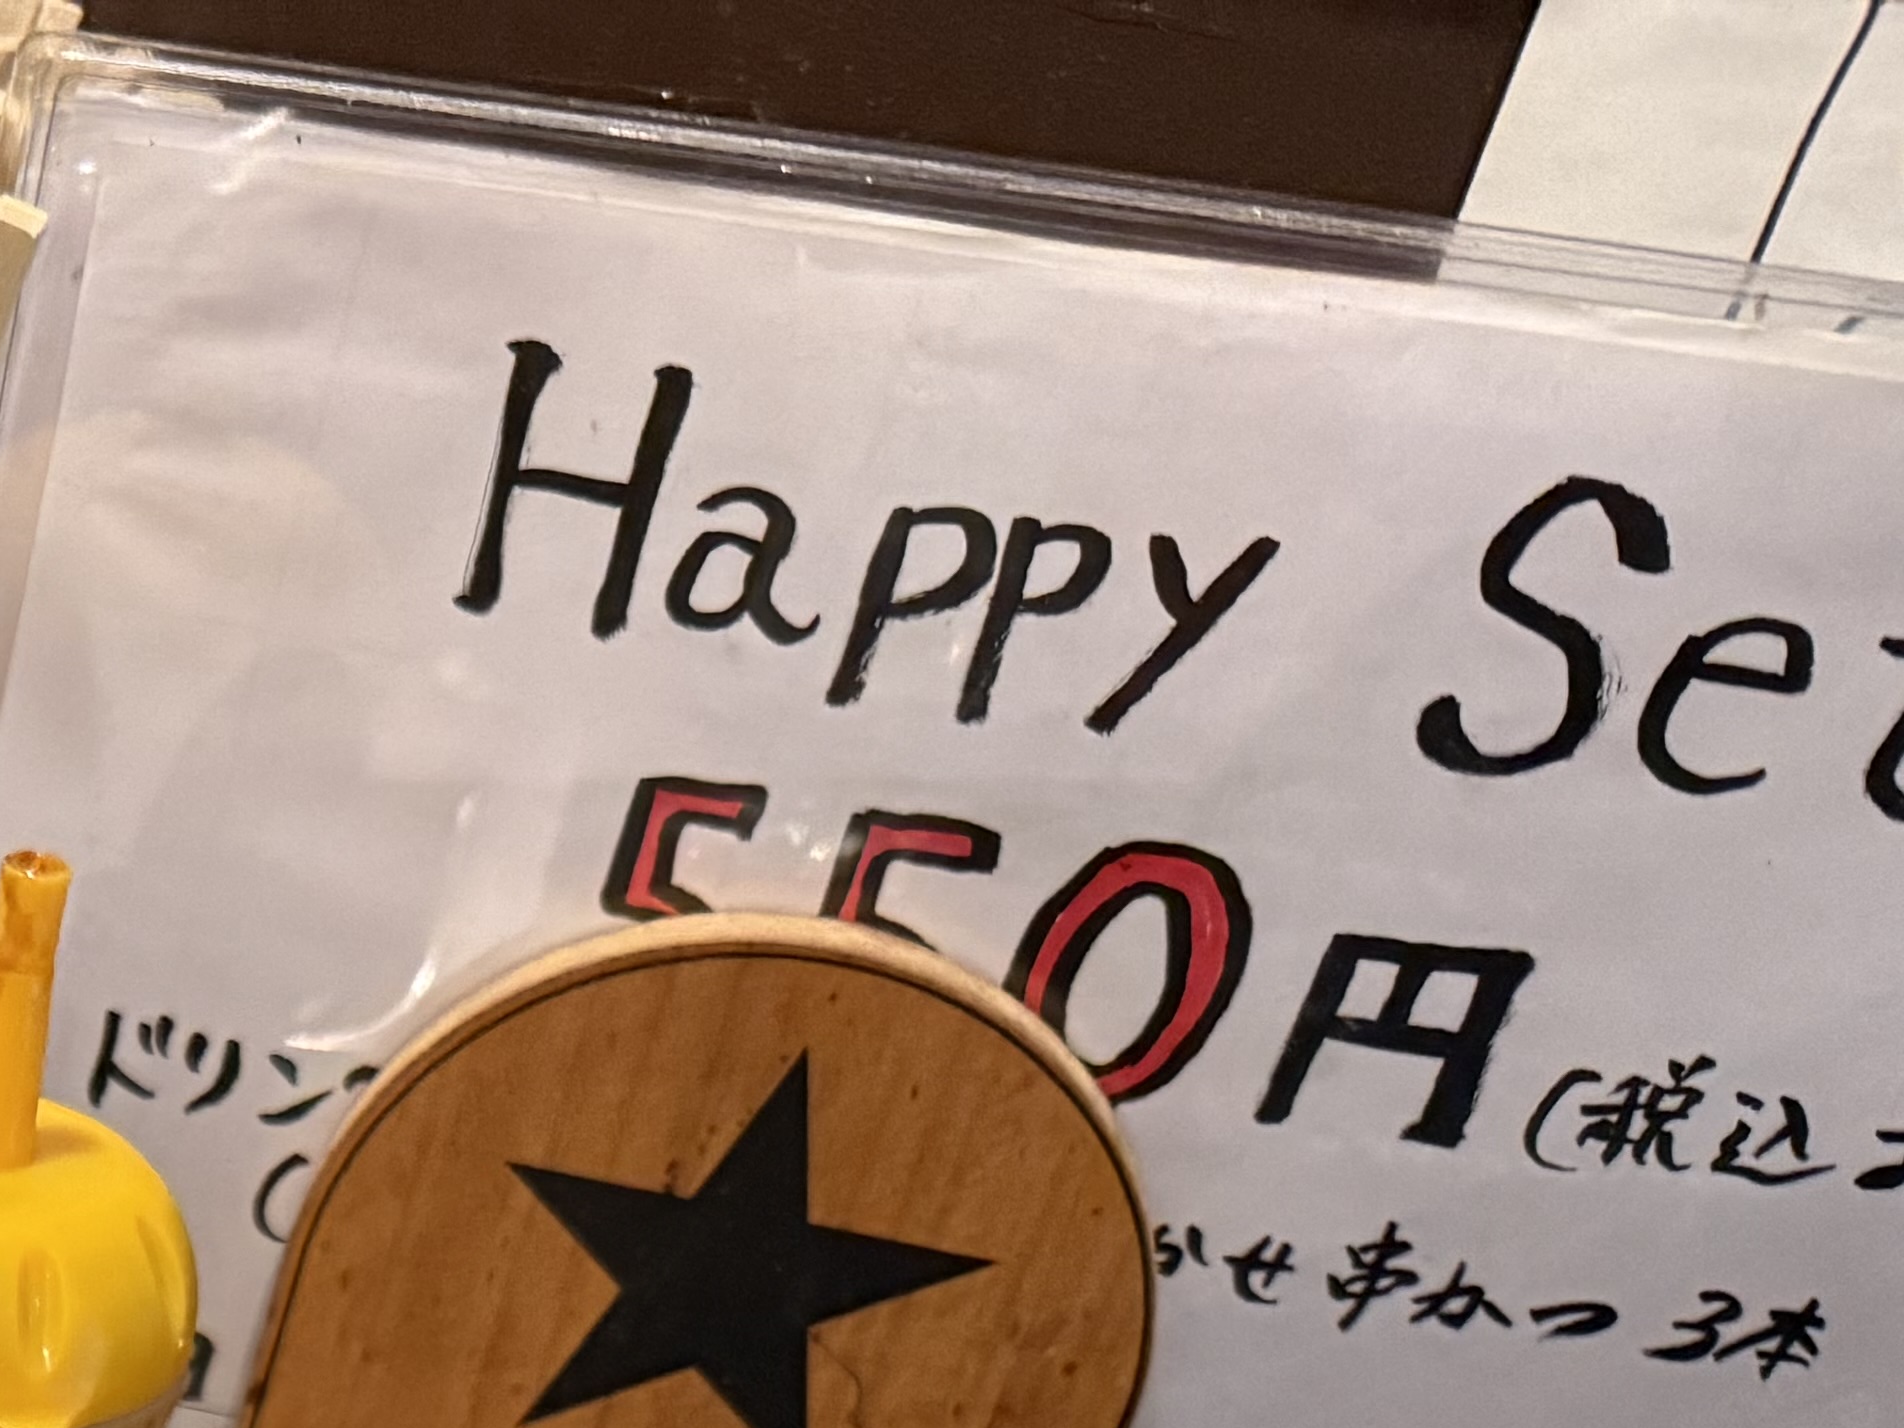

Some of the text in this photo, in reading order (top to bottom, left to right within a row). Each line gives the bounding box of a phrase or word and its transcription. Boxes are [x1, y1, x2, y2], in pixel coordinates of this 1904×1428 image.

[454, 338, 1281, 735] Happy
[86, 1008, 382, 1128] ドリン
